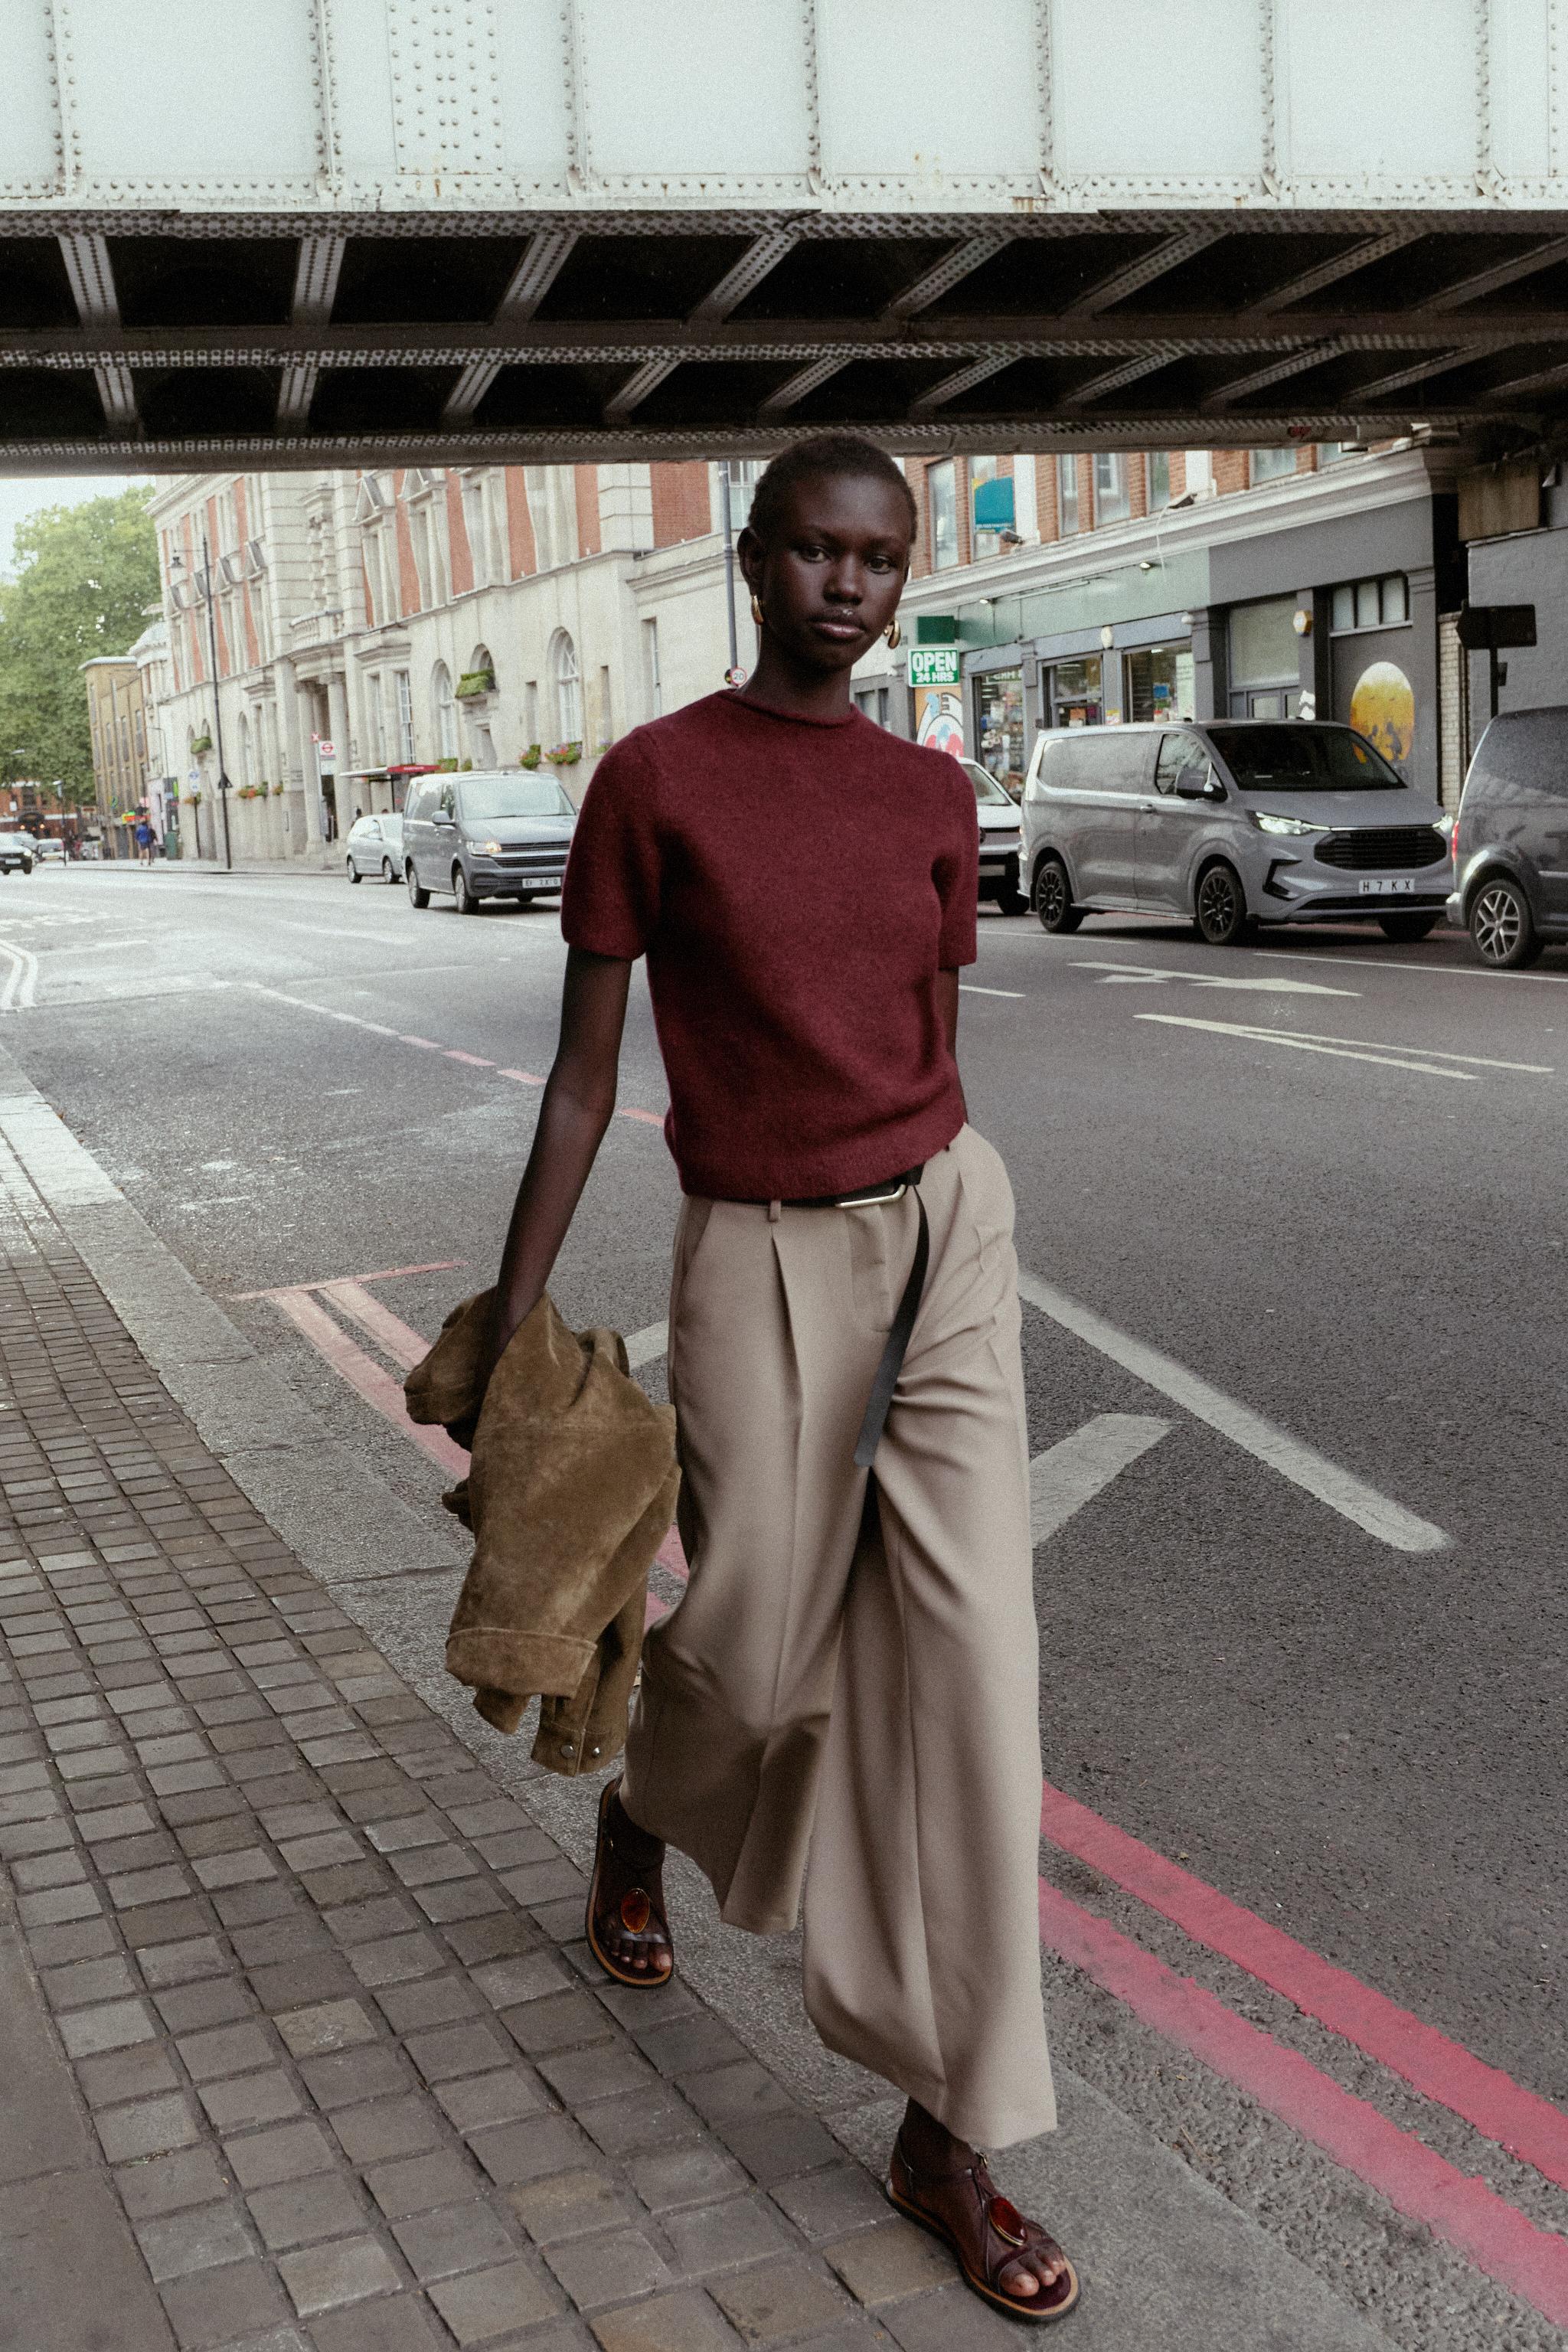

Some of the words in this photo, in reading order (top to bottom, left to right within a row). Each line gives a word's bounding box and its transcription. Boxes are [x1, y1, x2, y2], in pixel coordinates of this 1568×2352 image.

[912, 652, 957, 672] OPEN
[733, 672, 744, 681] 20
[916, 673, 931, 683] 24
[932, 671, 955, 682] HRS
